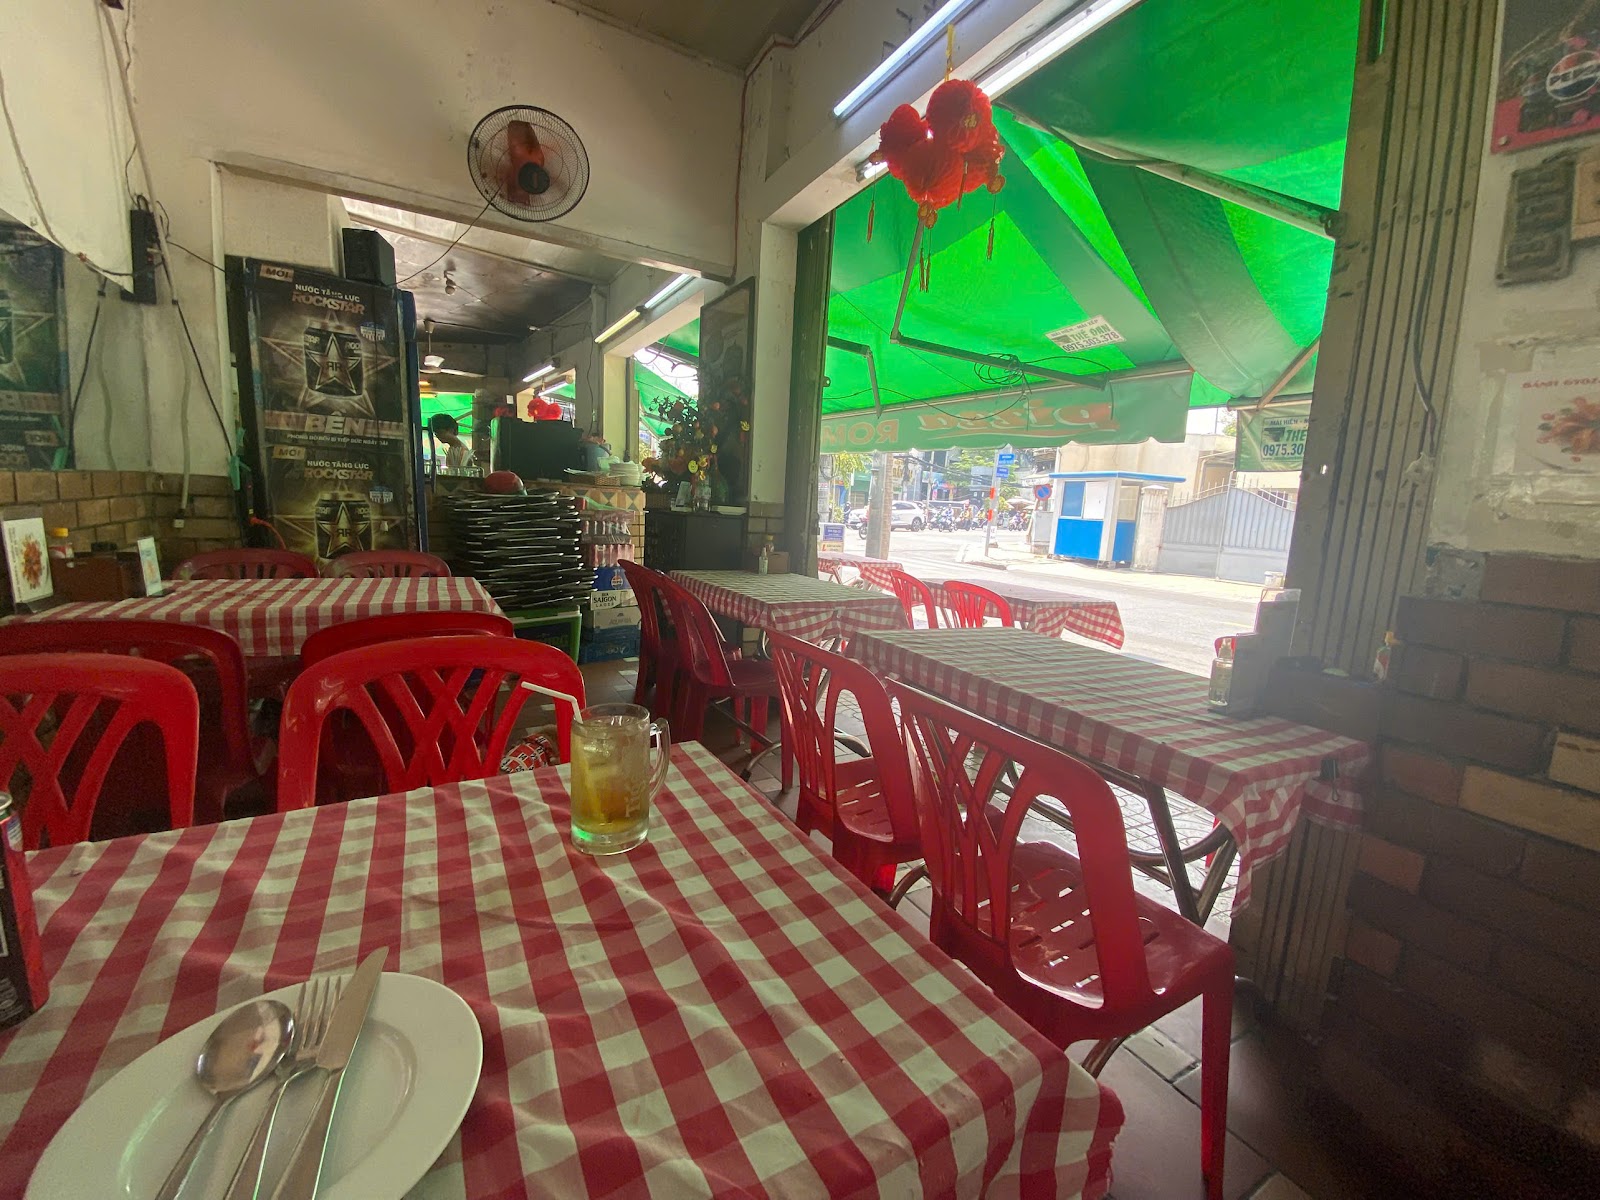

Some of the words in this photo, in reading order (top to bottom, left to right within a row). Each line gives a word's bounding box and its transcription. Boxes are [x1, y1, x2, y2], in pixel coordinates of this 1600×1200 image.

[291, 291, 366, 315] ROCKSTAR
[307, 459, 331, 468] NƯỚC
[331, 460, 353, 469] TĂNG
[354, 462, 369, 470] LỰC
[304, 468, 374, 481] ROCKSTAR
[593, 596, 617, 604] SAIGON
